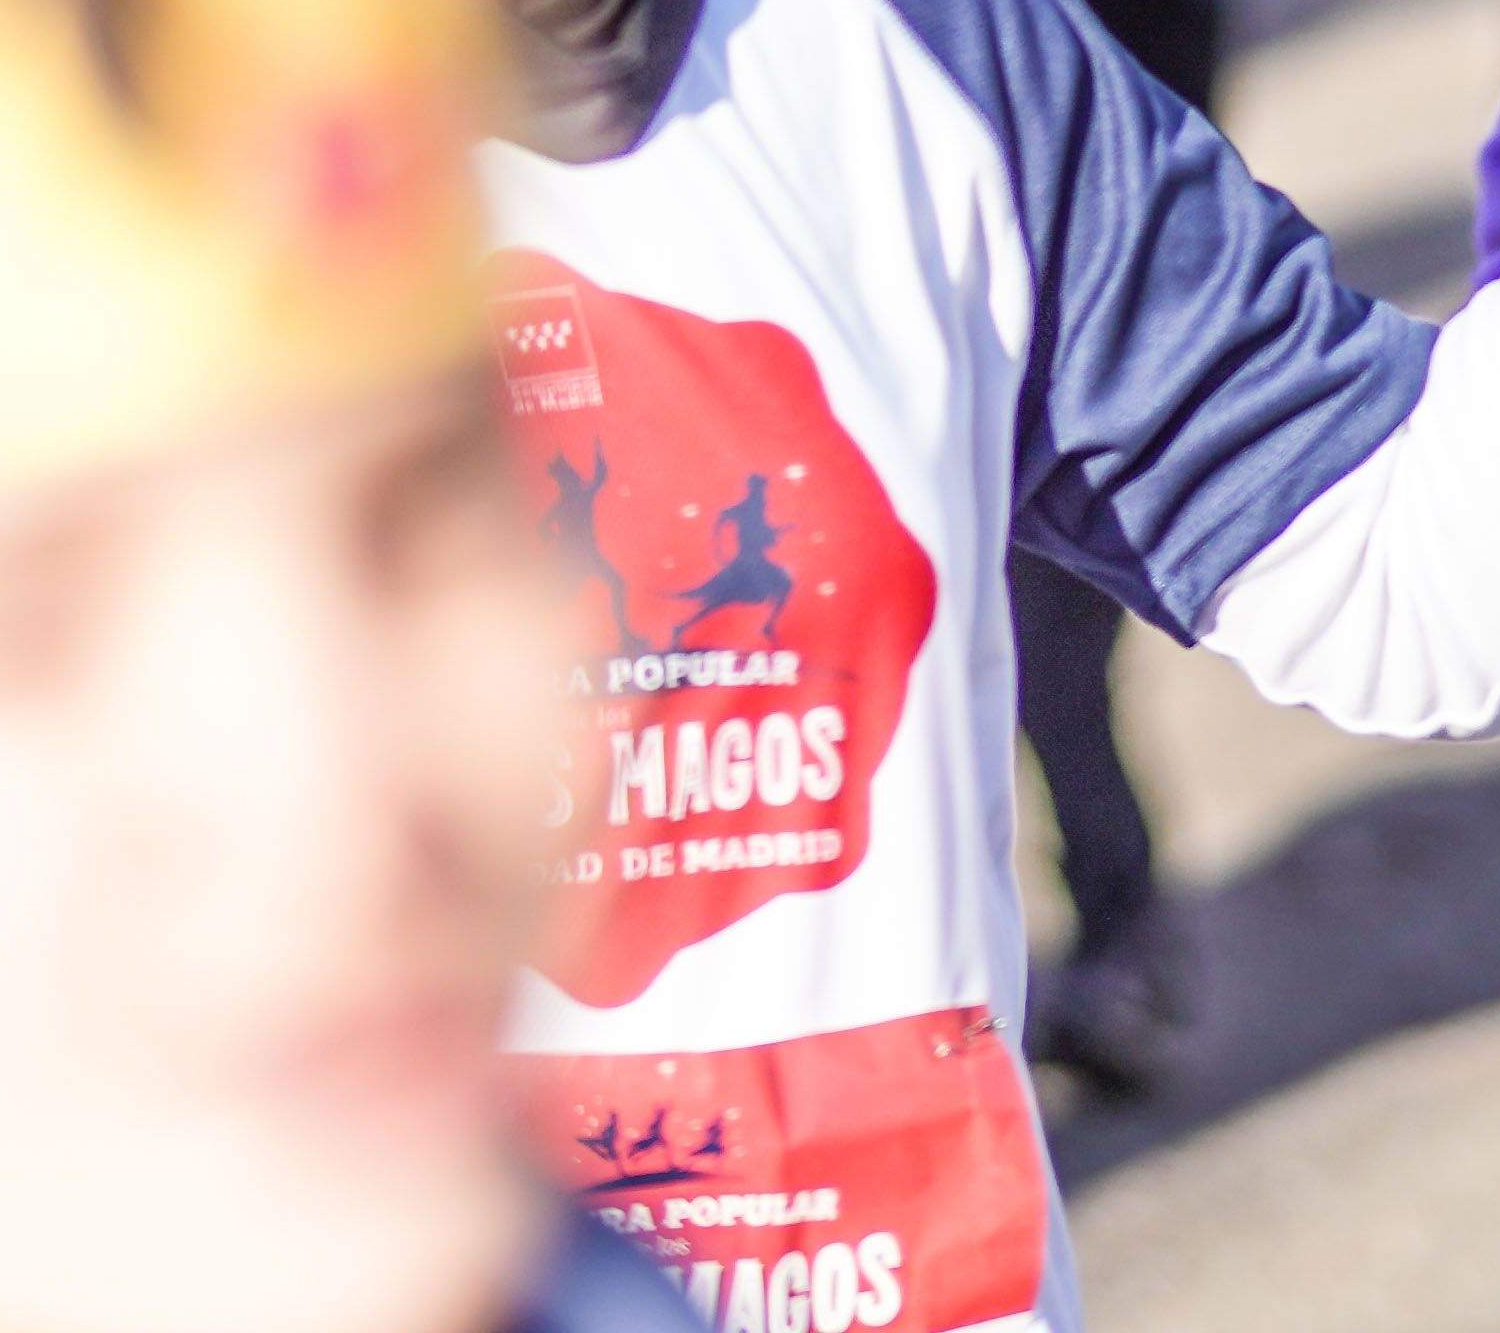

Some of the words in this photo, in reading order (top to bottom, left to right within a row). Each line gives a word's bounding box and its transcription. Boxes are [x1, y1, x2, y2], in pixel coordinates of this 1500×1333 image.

[607, 650, 800, 694] POPULAR
[607, 705, 847, 827] MAGOS
[620, 843, 676, 881] DE
[682, 828, 844, 875] MADRID
[663, 1188, 840, 1229] POPULAR
